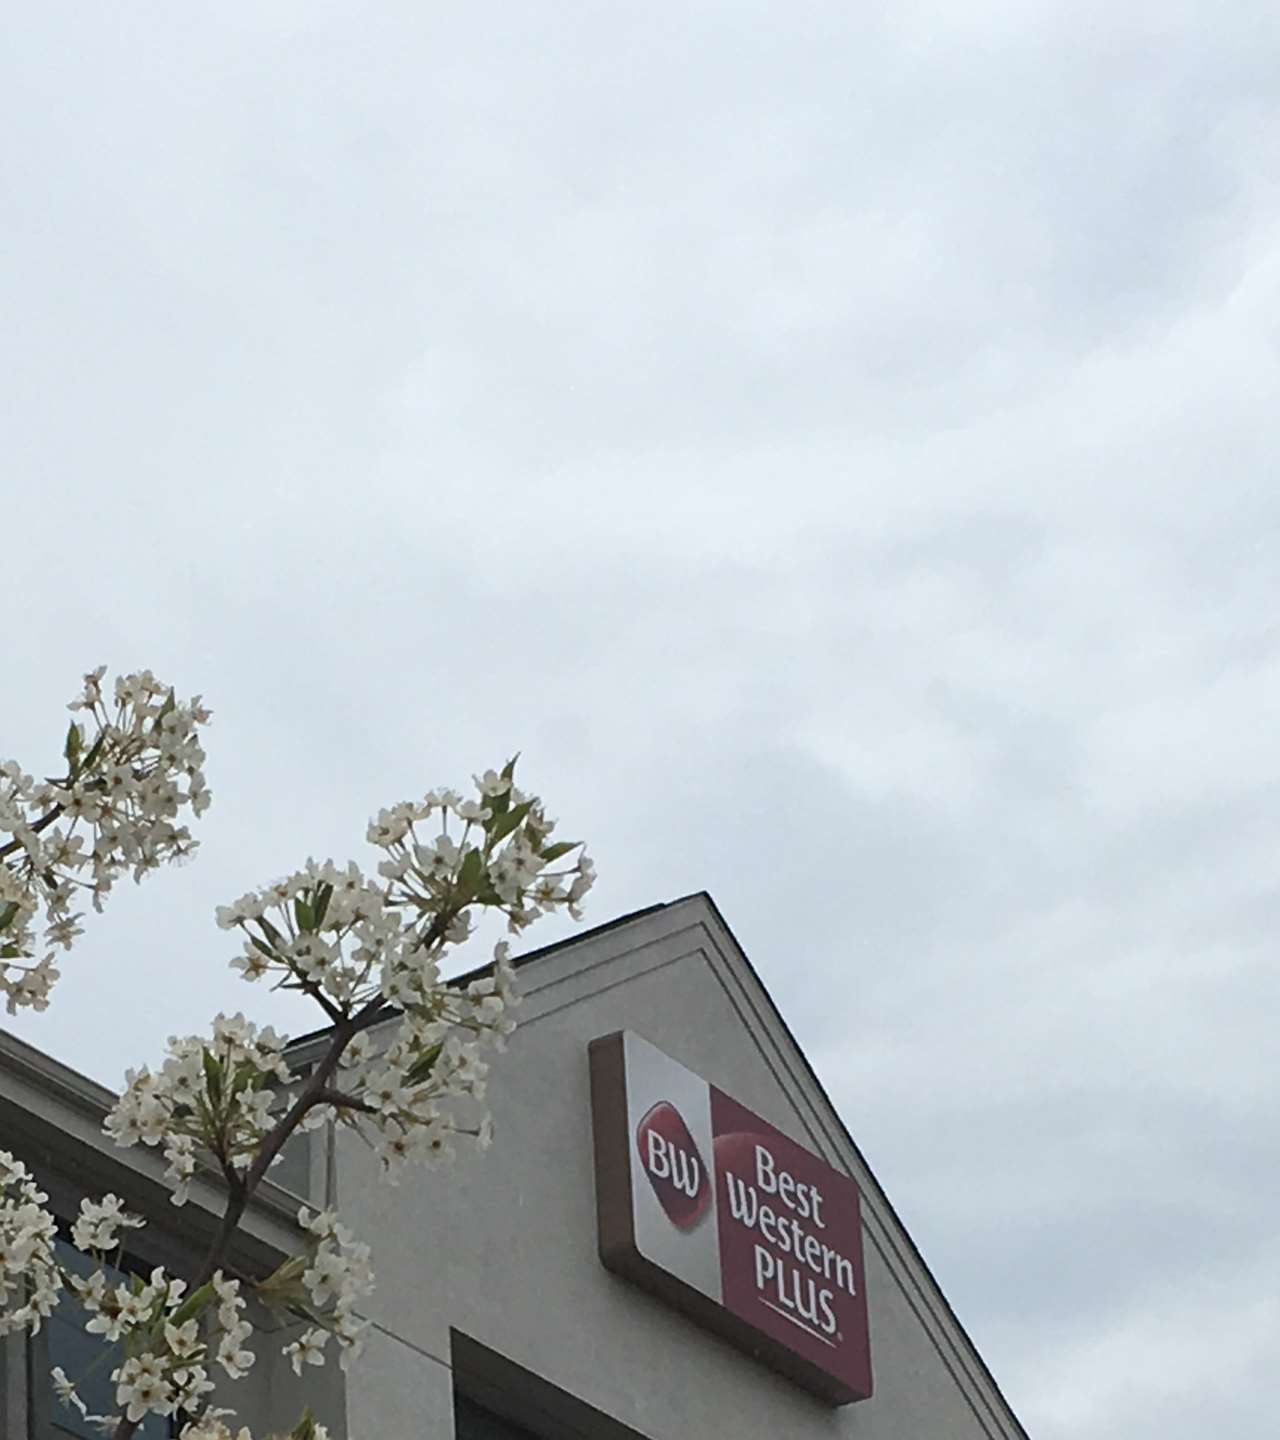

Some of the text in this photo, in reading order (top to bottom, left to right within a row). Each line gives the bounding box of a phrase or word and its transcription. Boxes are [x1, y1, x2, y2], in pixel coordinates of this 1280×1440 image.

[646, 1128, 699, 1198] BW
[755, 1144, 826, 1228] Best
[725, 1171, 857, 1297] Western
[754, 1244, 838, 1335] PLUS
